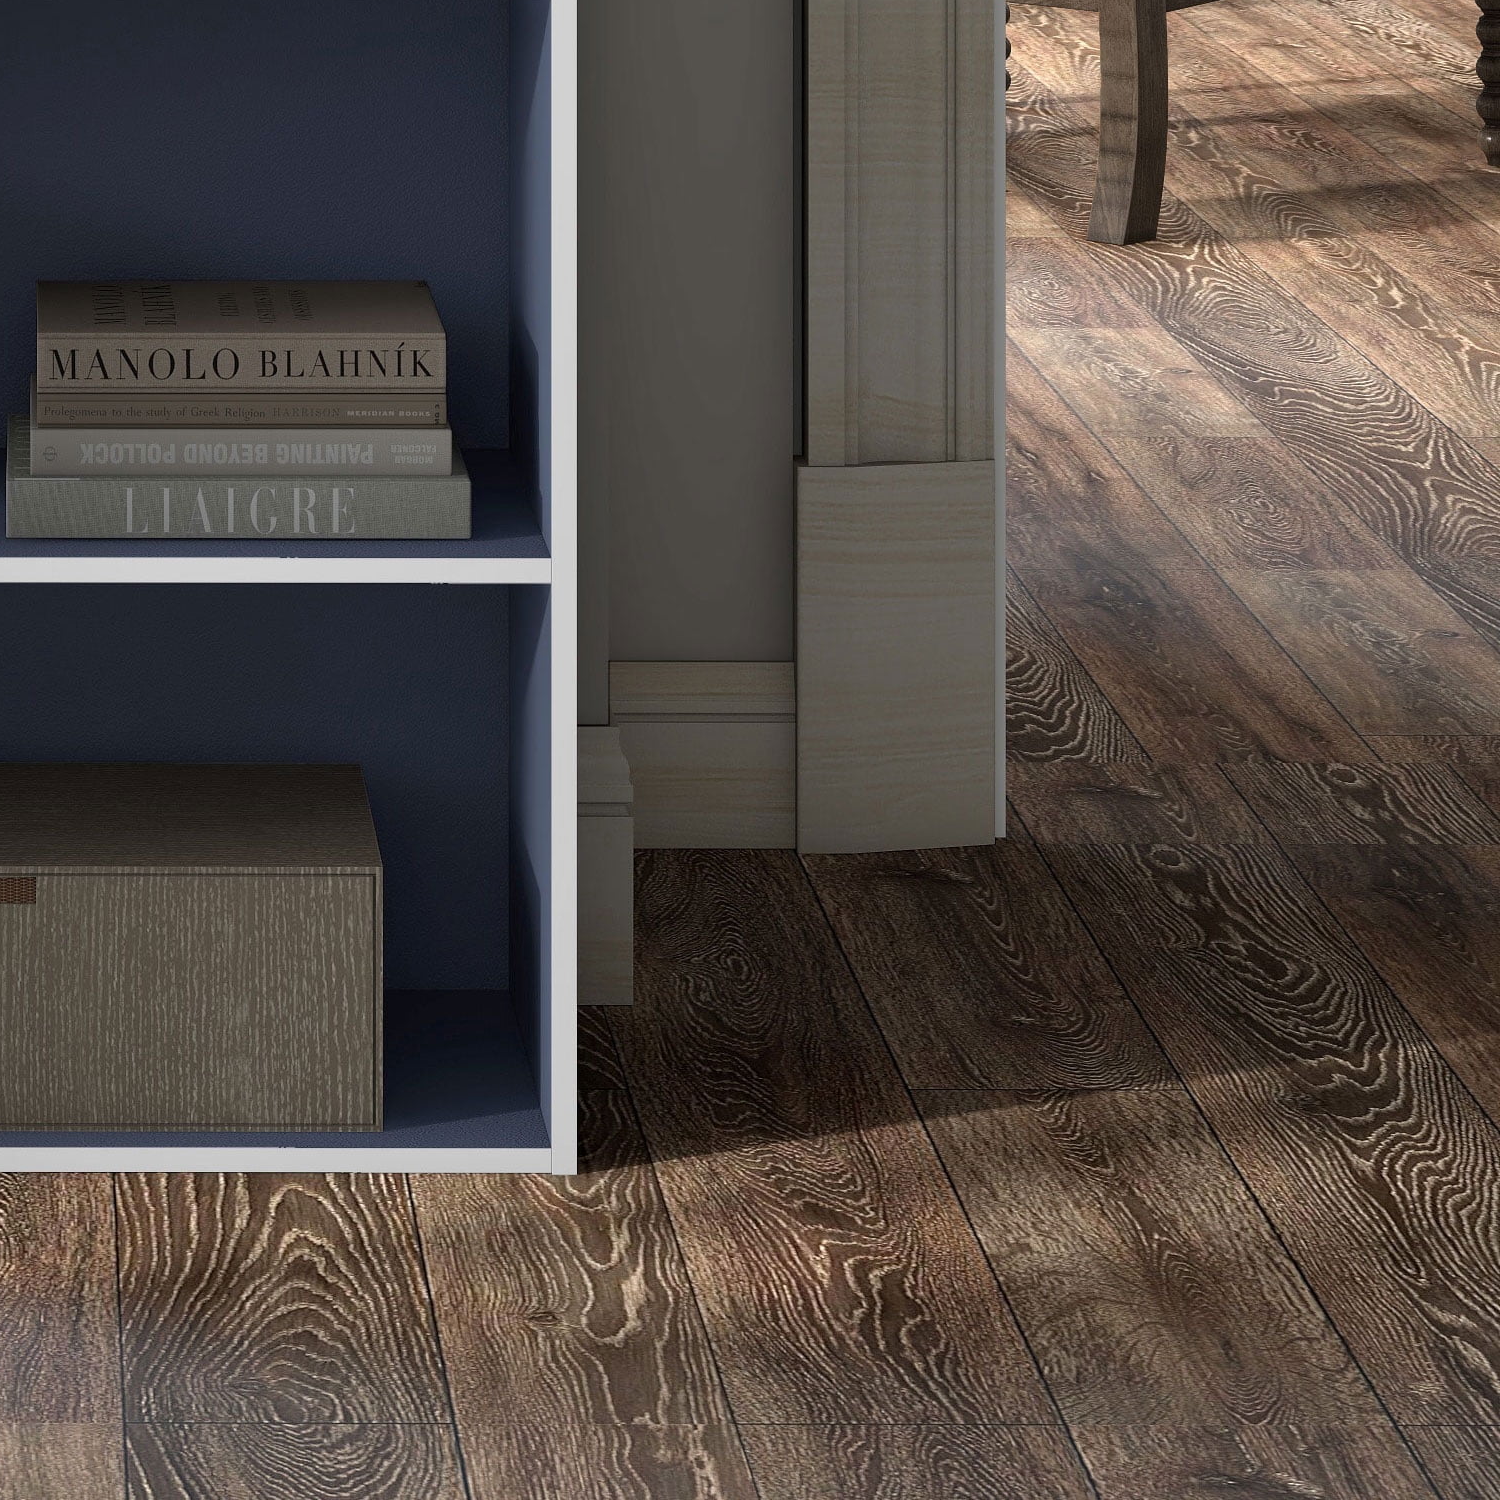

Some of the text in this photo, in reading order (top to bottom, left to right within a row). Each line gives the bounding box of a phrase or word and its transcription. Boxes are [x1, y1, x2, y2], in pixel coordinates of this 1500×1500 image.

[48, 341, 434, 381] MANOLO BLAHNÍK
[43, 406, 107, 421] Prolegomena
[112, 407, 122, 417] to
[126, 407, 142, 417] the
[145, 406, 172, 421] study
[176, 406, 188, 417] of
[190, 406, 219, 417] Greek
[224, 407, 266, 421] Religion
[273, 408, 340, 418] HARRISON
[79, 443, 374, 466] PAINTING BEYOND POLLOCK
[125, 486, 357, 534] LIAIGRE
